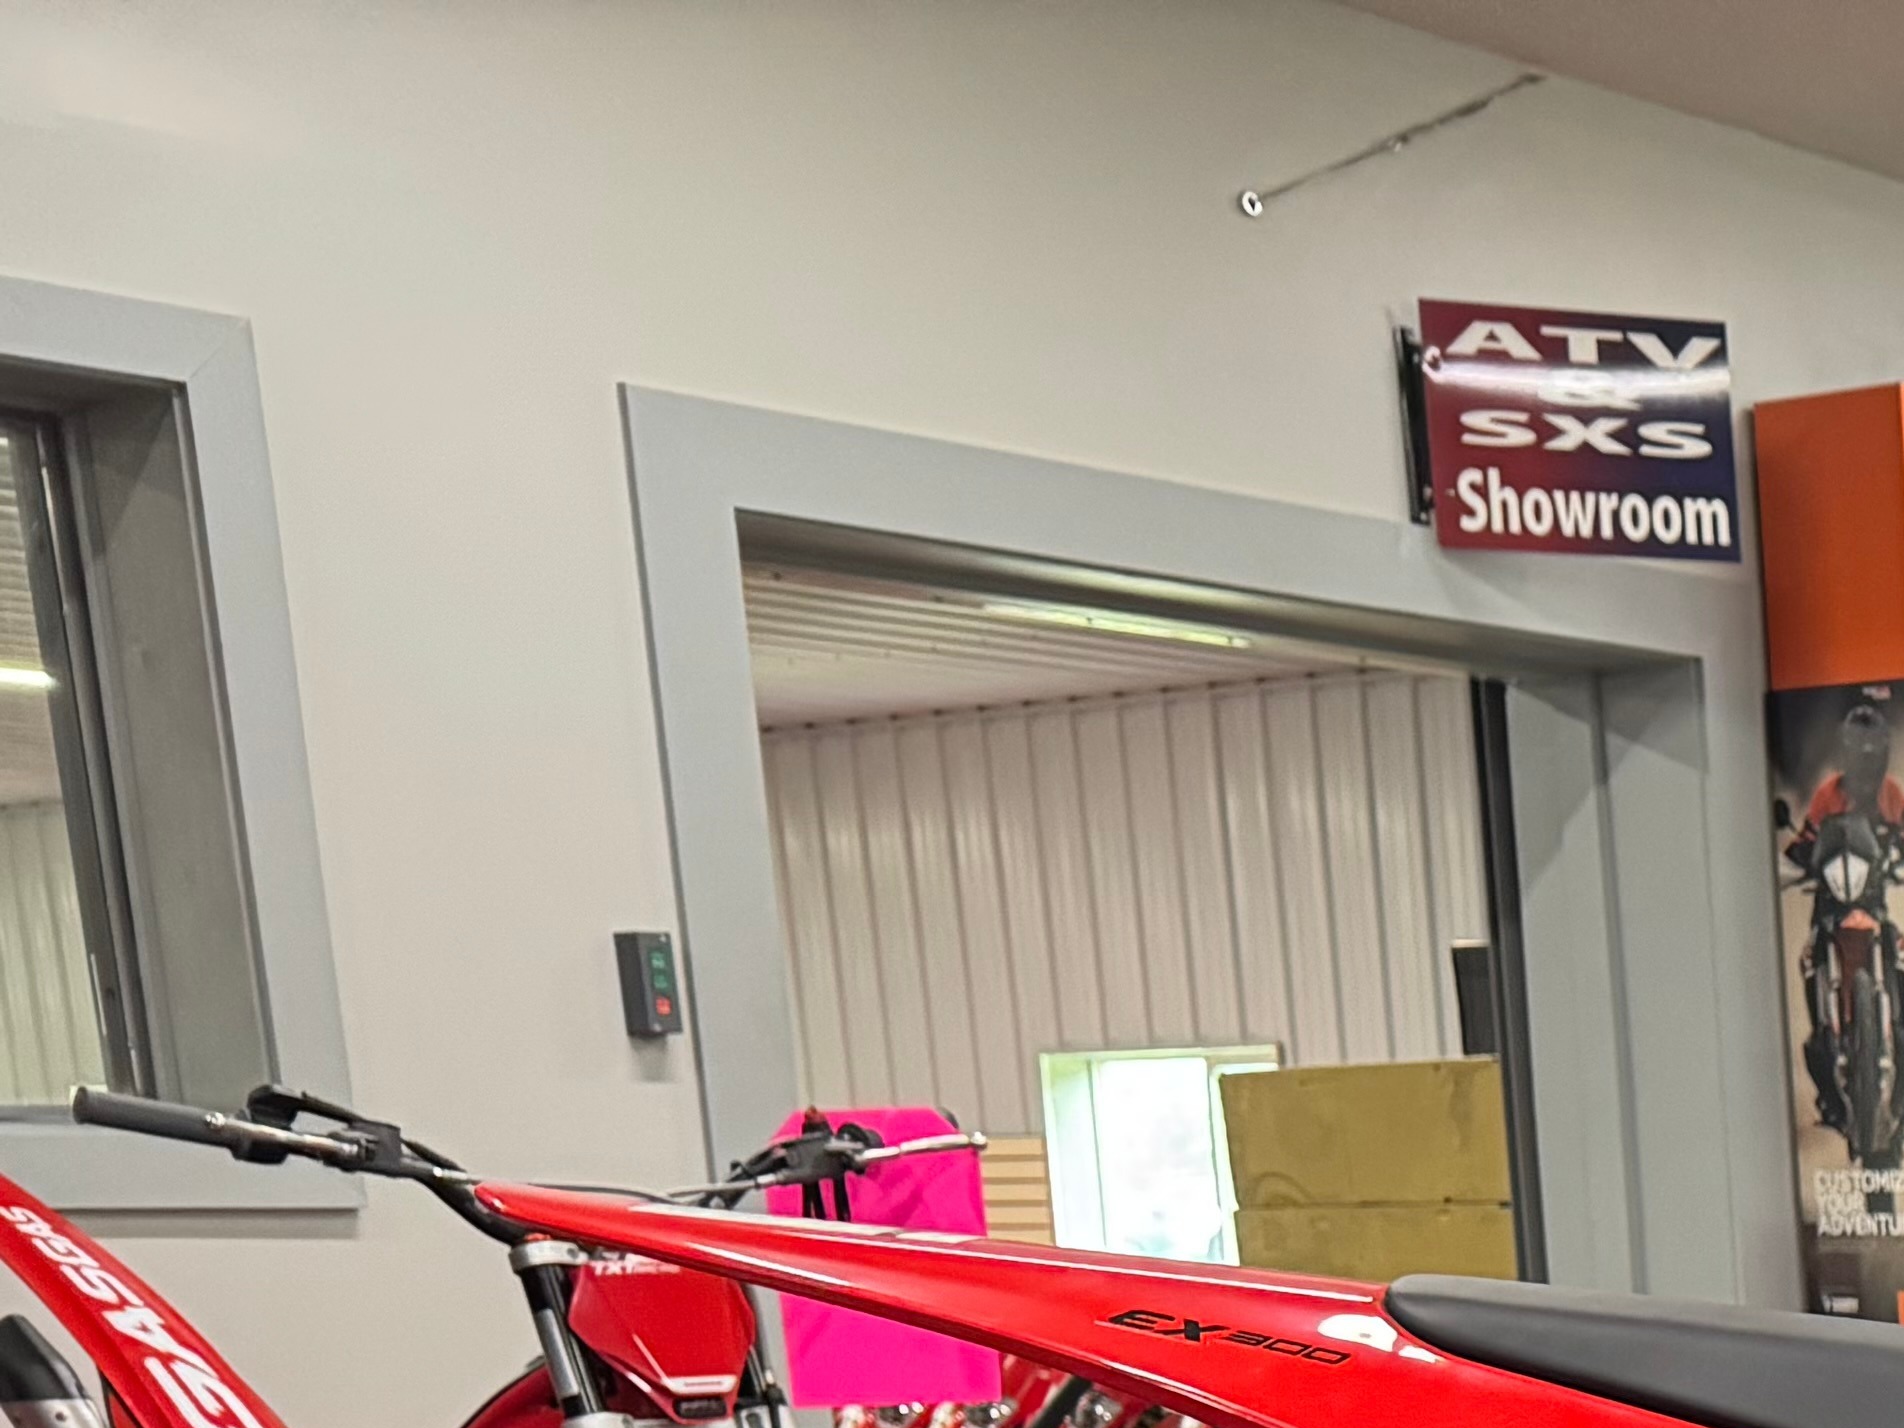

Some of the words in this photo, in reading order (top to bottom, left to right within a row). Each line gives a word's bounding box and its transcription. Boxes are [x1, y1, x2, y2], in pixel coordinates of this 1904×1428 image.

[1446, 320, 1722, 368] ATV
[1459, 410, 1713, 459] SXS
[1457, 466, 1730, 547] Showroom
